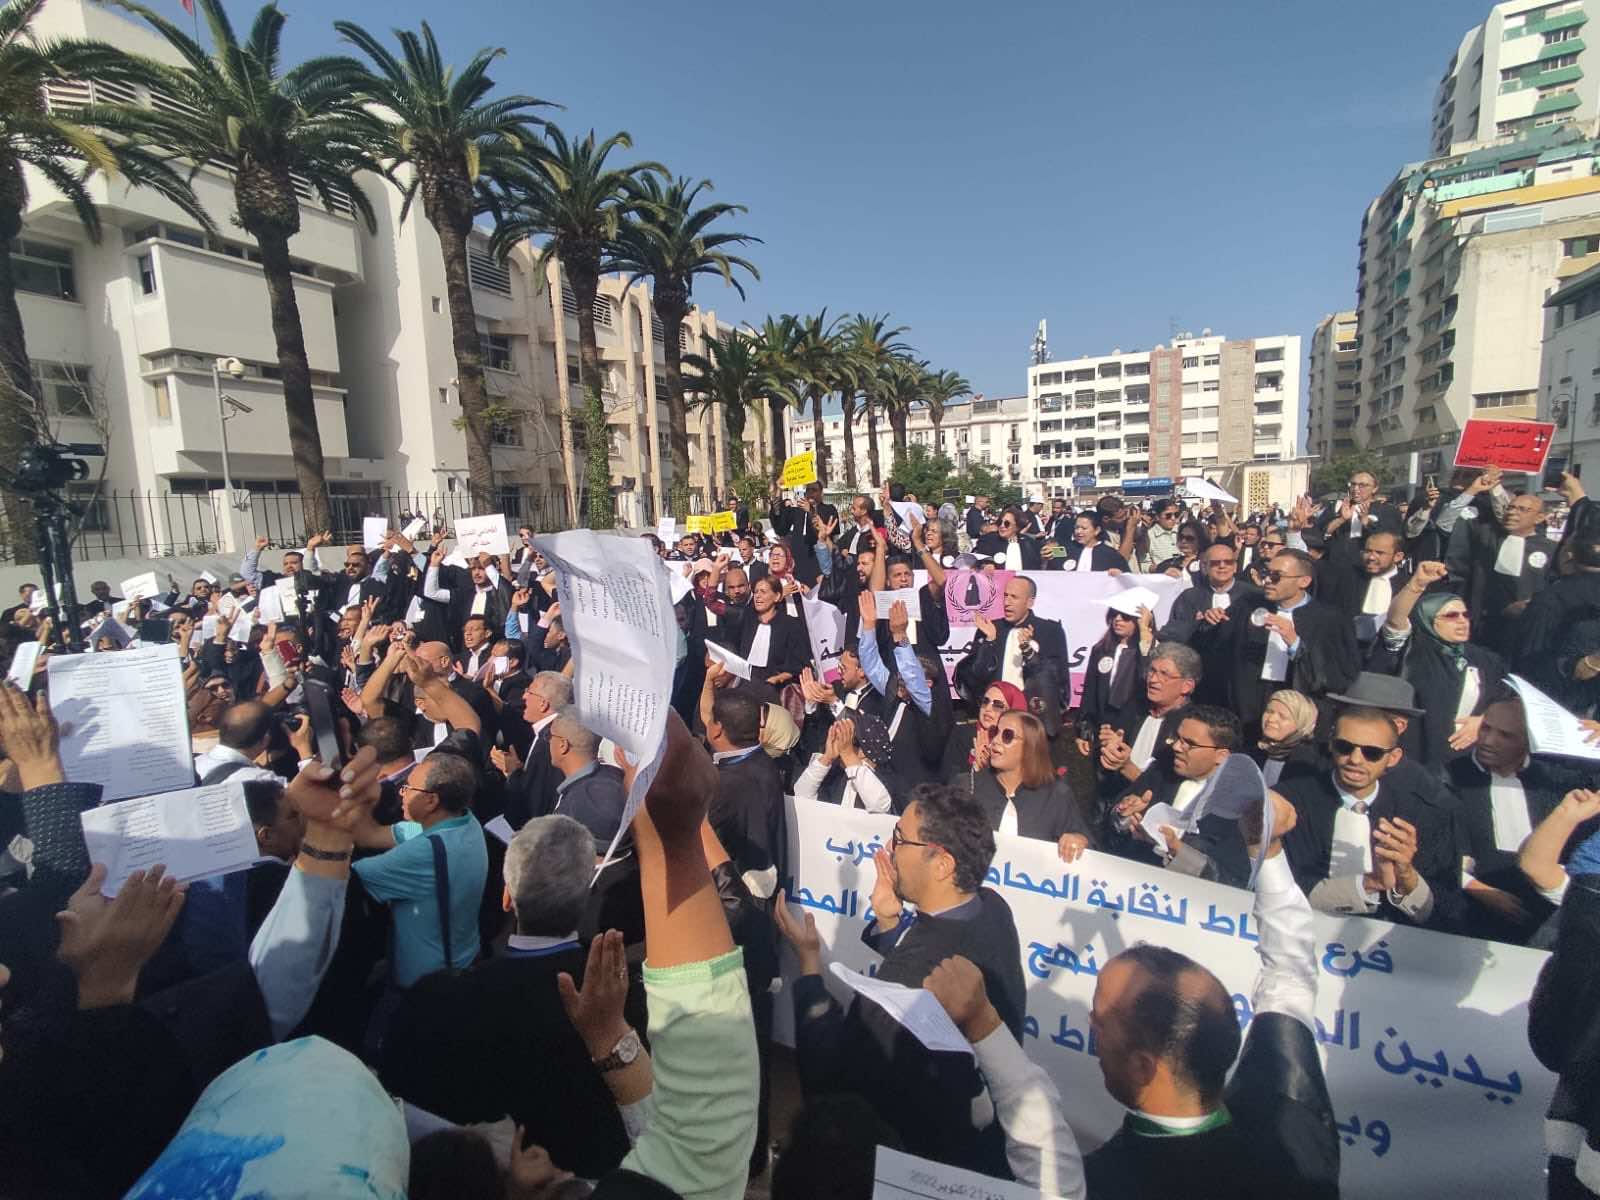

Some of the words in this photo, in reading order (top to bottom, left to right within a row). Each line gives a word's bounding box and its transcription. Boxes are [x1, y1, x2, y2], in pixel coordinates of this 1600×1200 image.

[984, 861, 1080, 901] المحام
[1086, 878, 1188, 925] لنقابة
[1321, 939, 1394, 978] فرع
[1374, 1026, 1522, 1105] يدين
